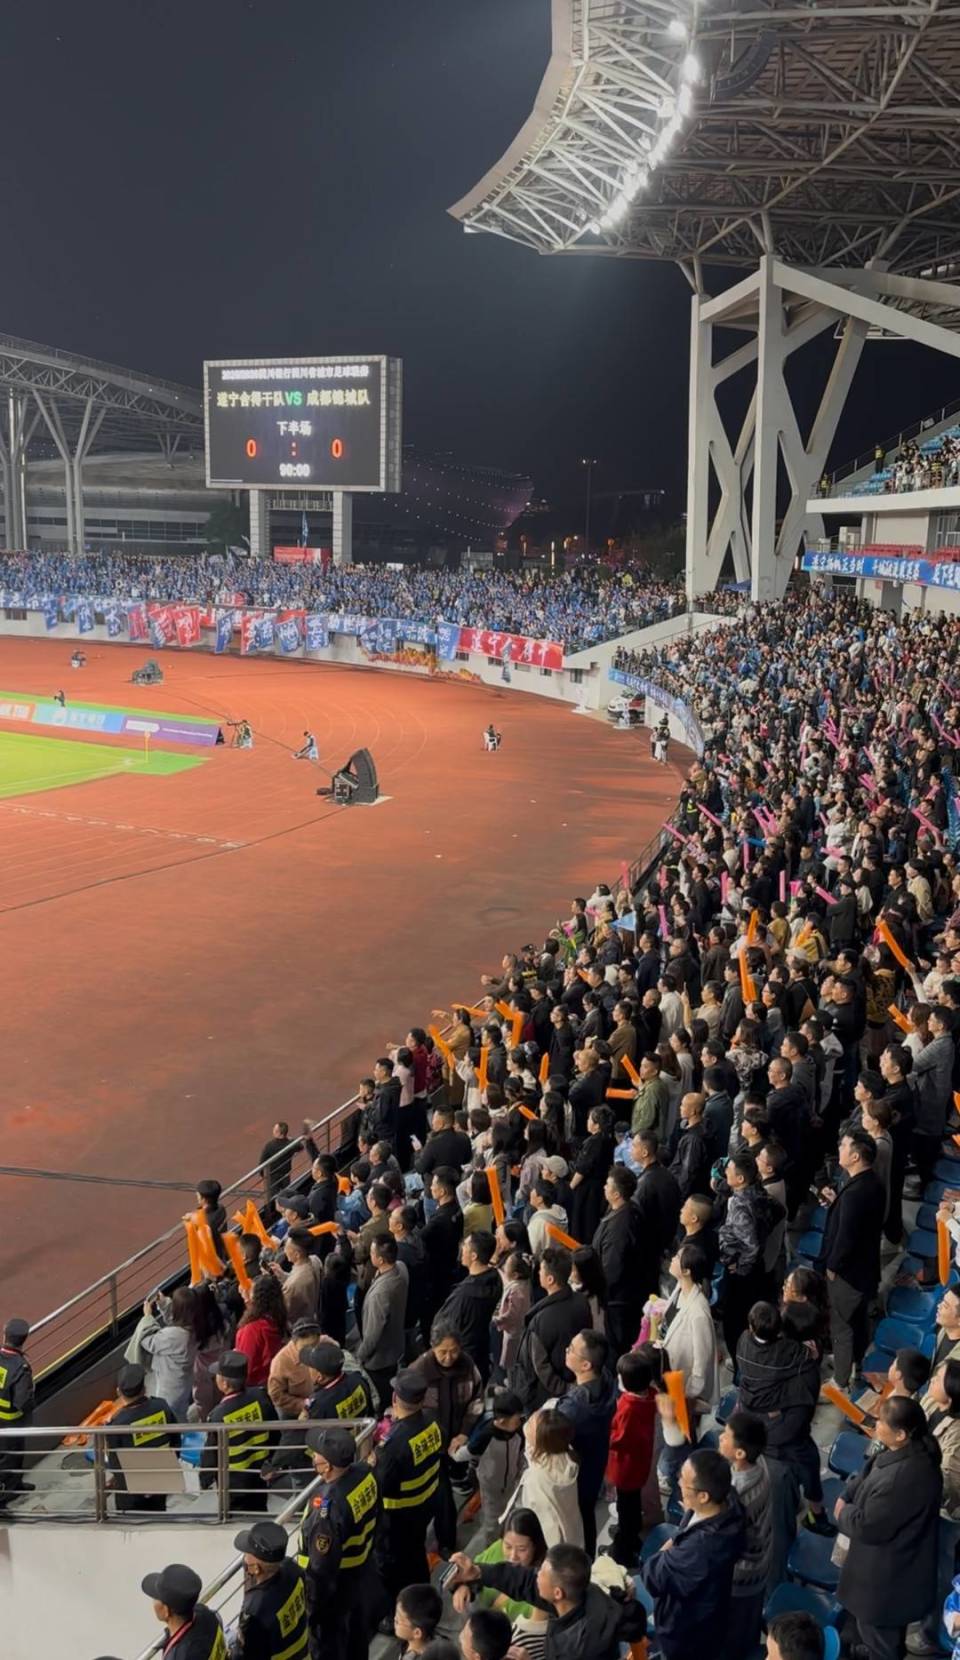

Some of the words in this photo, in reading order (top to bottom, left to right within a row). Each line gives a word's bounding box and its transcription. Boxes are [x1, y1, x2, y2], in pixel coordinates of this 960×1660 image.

[285, 391, 303, 406] VS
[277, 421, 312, 437] 下半场
[246, 438, 257, 458] 0
[332, 438, 343, 459] 0
